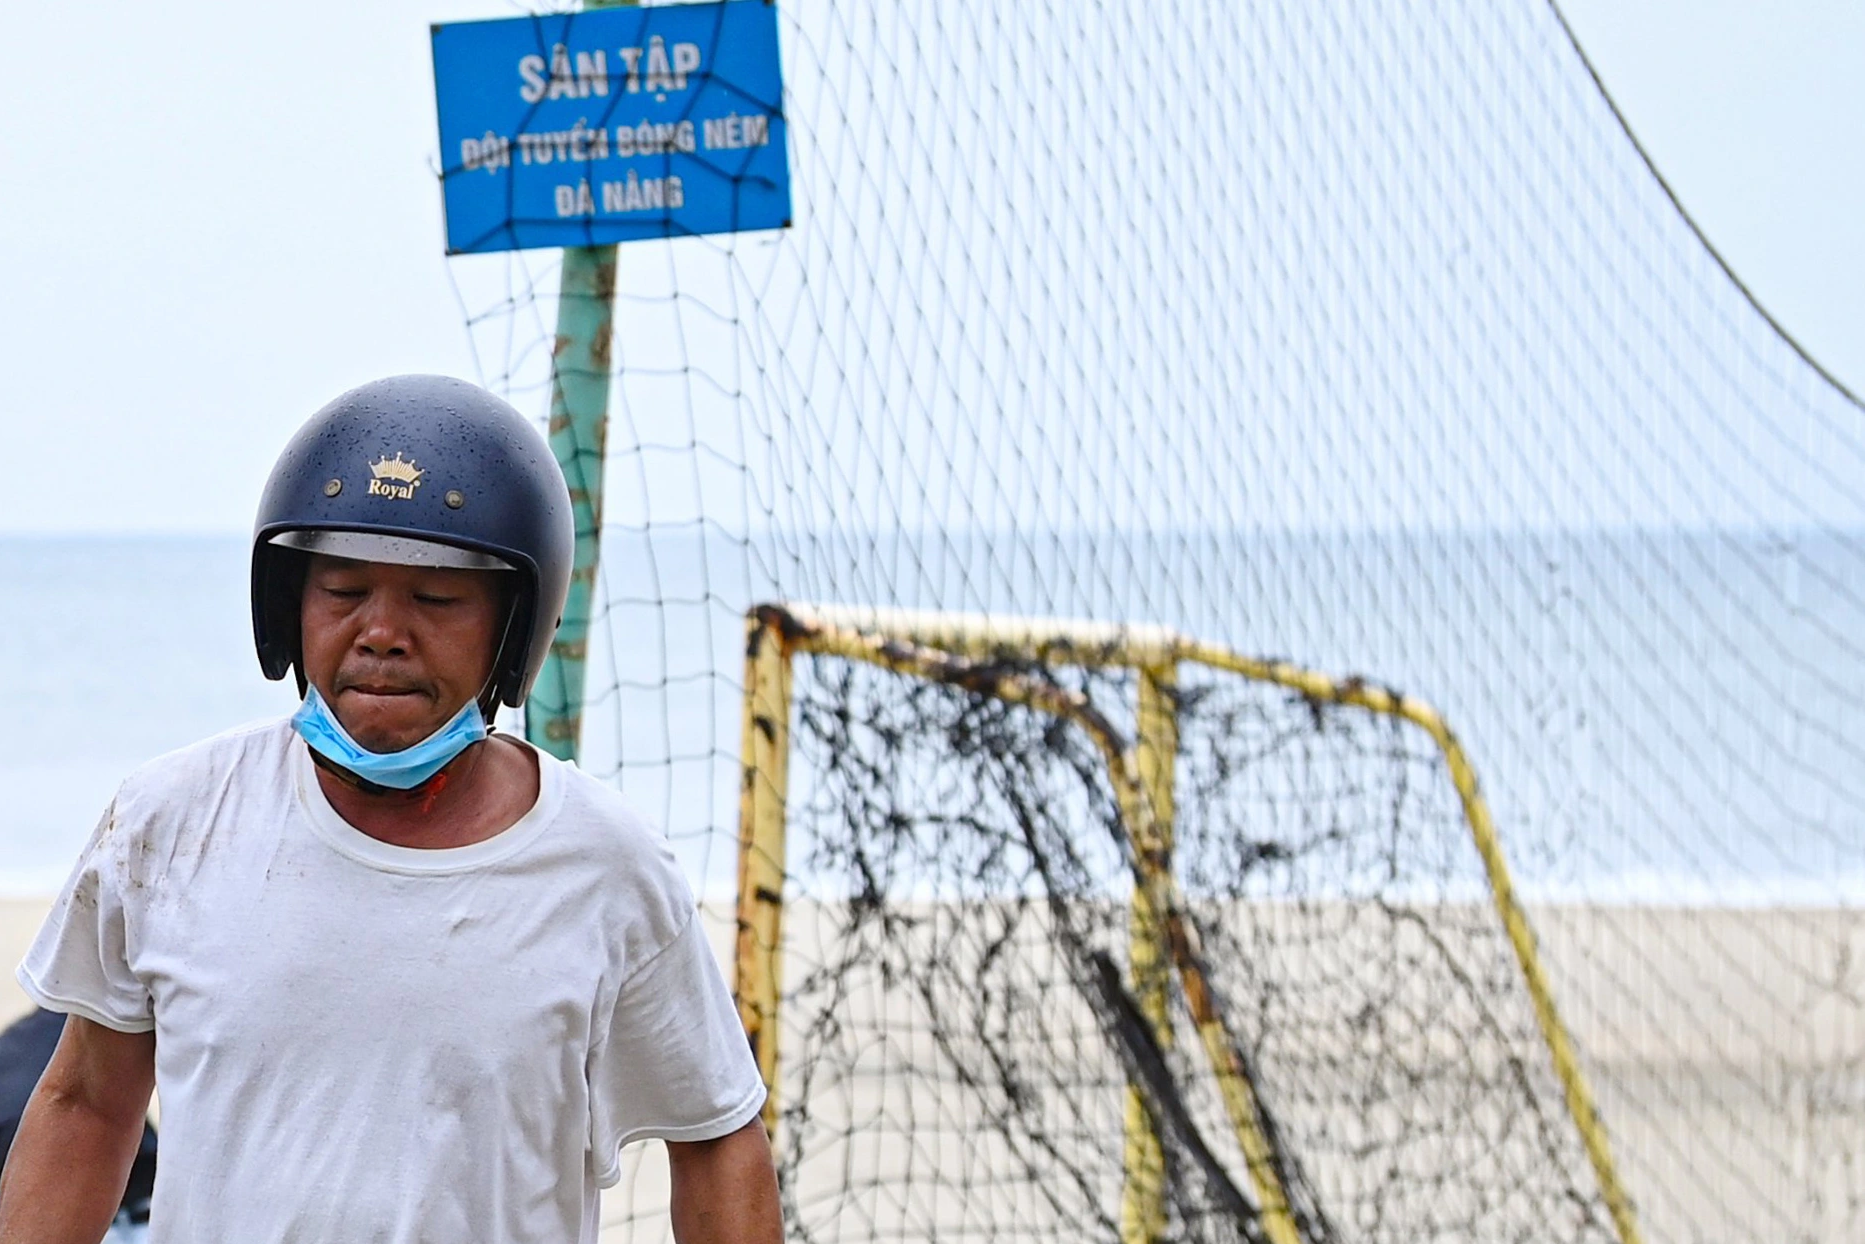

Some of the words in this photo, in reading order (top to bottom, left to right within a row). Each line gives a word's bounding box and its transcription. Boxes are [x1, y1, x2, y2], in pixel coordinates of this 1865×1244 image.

[518, 42, 609, 104] SÂN
[619, 34, 701, 103] TẬP
[460, 130, 513, 175] ĐỘI
[368, 478, 414, 500] Royal
